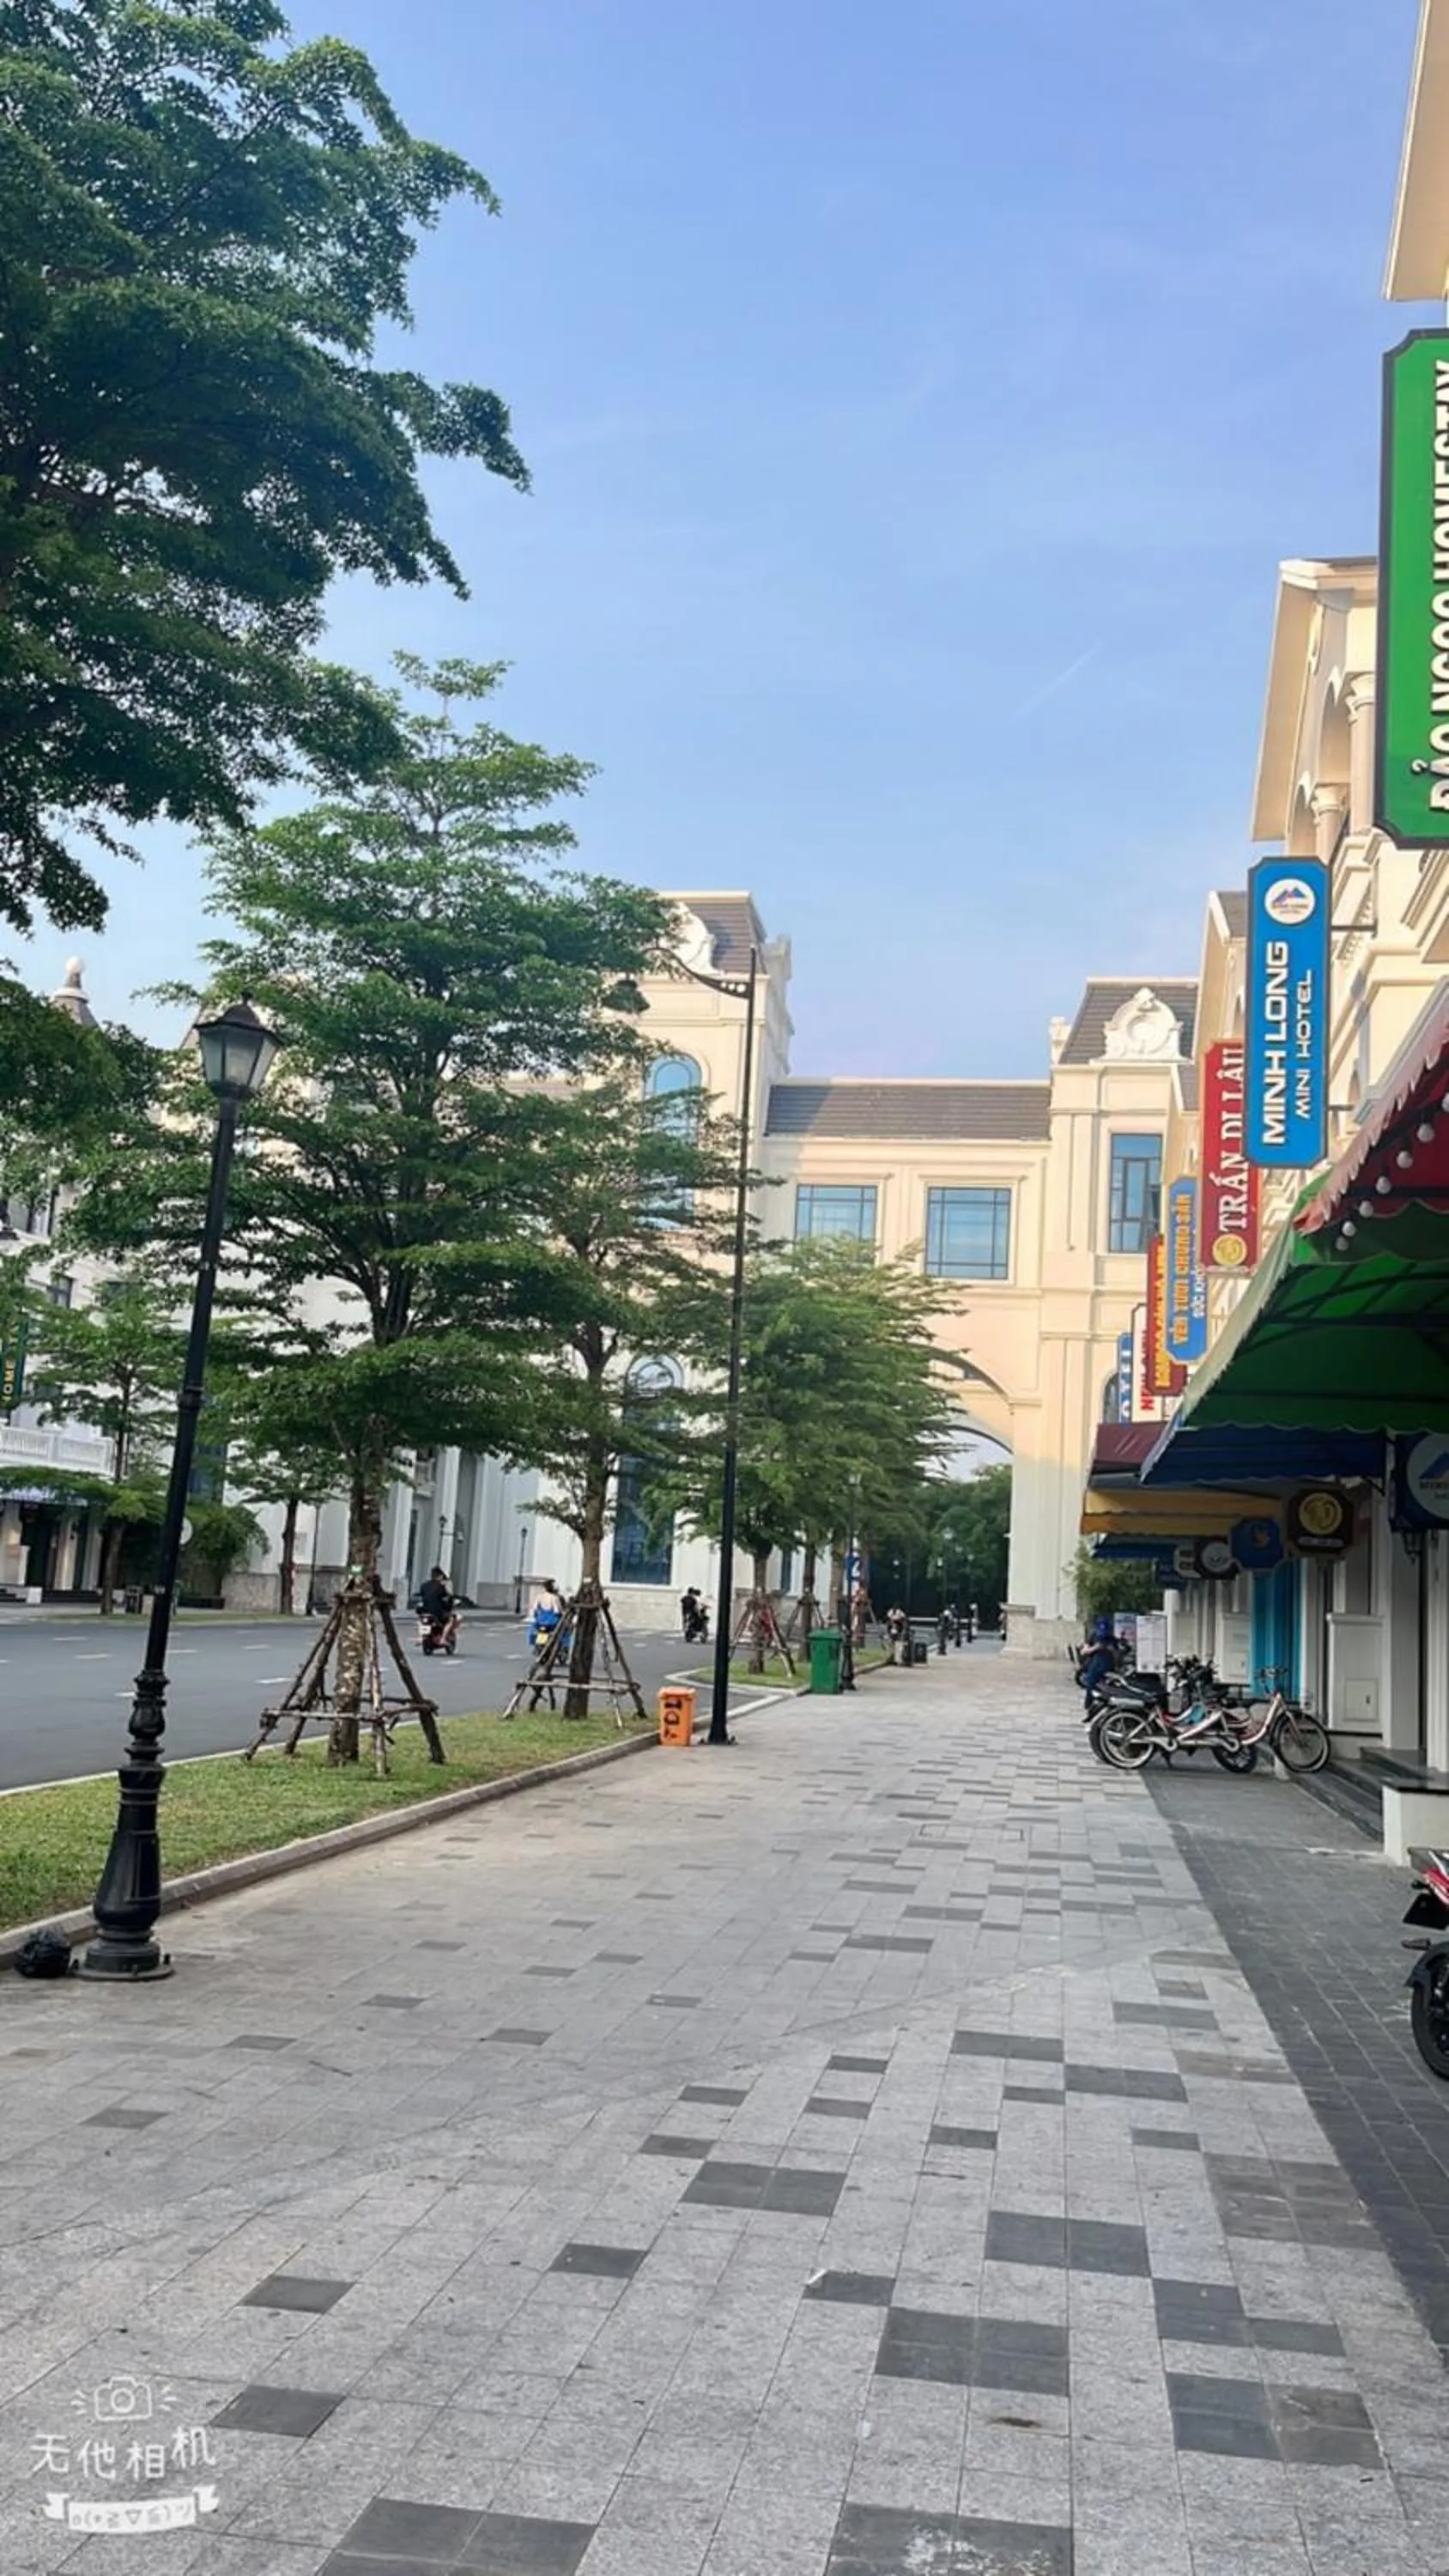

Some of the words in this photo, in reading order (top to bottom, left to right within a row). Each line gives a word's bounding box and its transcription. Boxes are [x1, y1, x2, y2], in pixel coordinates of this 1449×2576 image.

[1264, 941, 1288, 1041] LONG
[1295, 969, 1312, 1058] HOTEL
[1263, 1050, 1286, 1145] MINH
[1295, 1069, 1311, 1119] MINI
